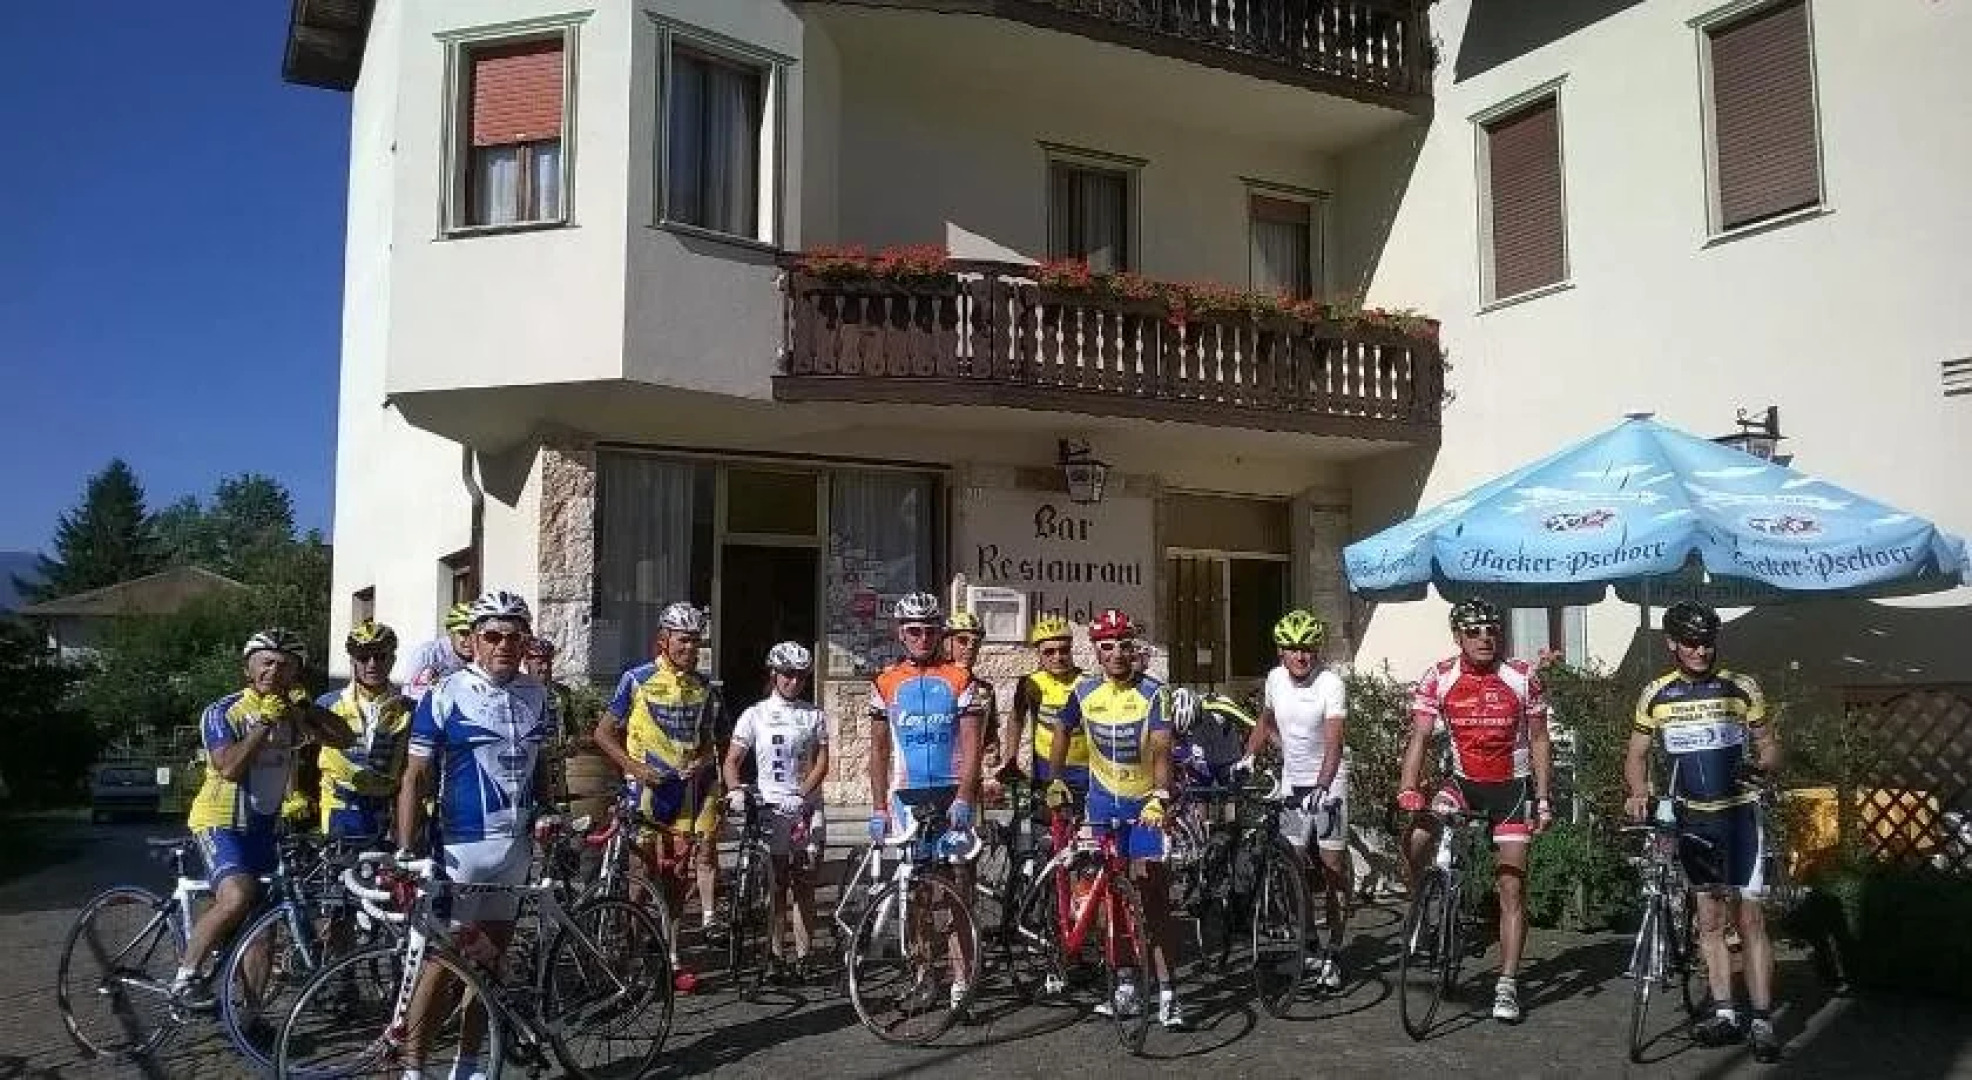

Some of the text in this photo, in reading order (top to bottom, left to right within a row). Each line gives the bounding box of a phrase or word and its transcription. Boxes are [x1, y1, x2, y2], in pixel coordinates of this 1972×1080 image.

[1033, 503, 1095, 541] Bar
[976, 543, 1142, 586] Restaurant
[1460, 541, 1667, 576] Hacker-Pschorr
